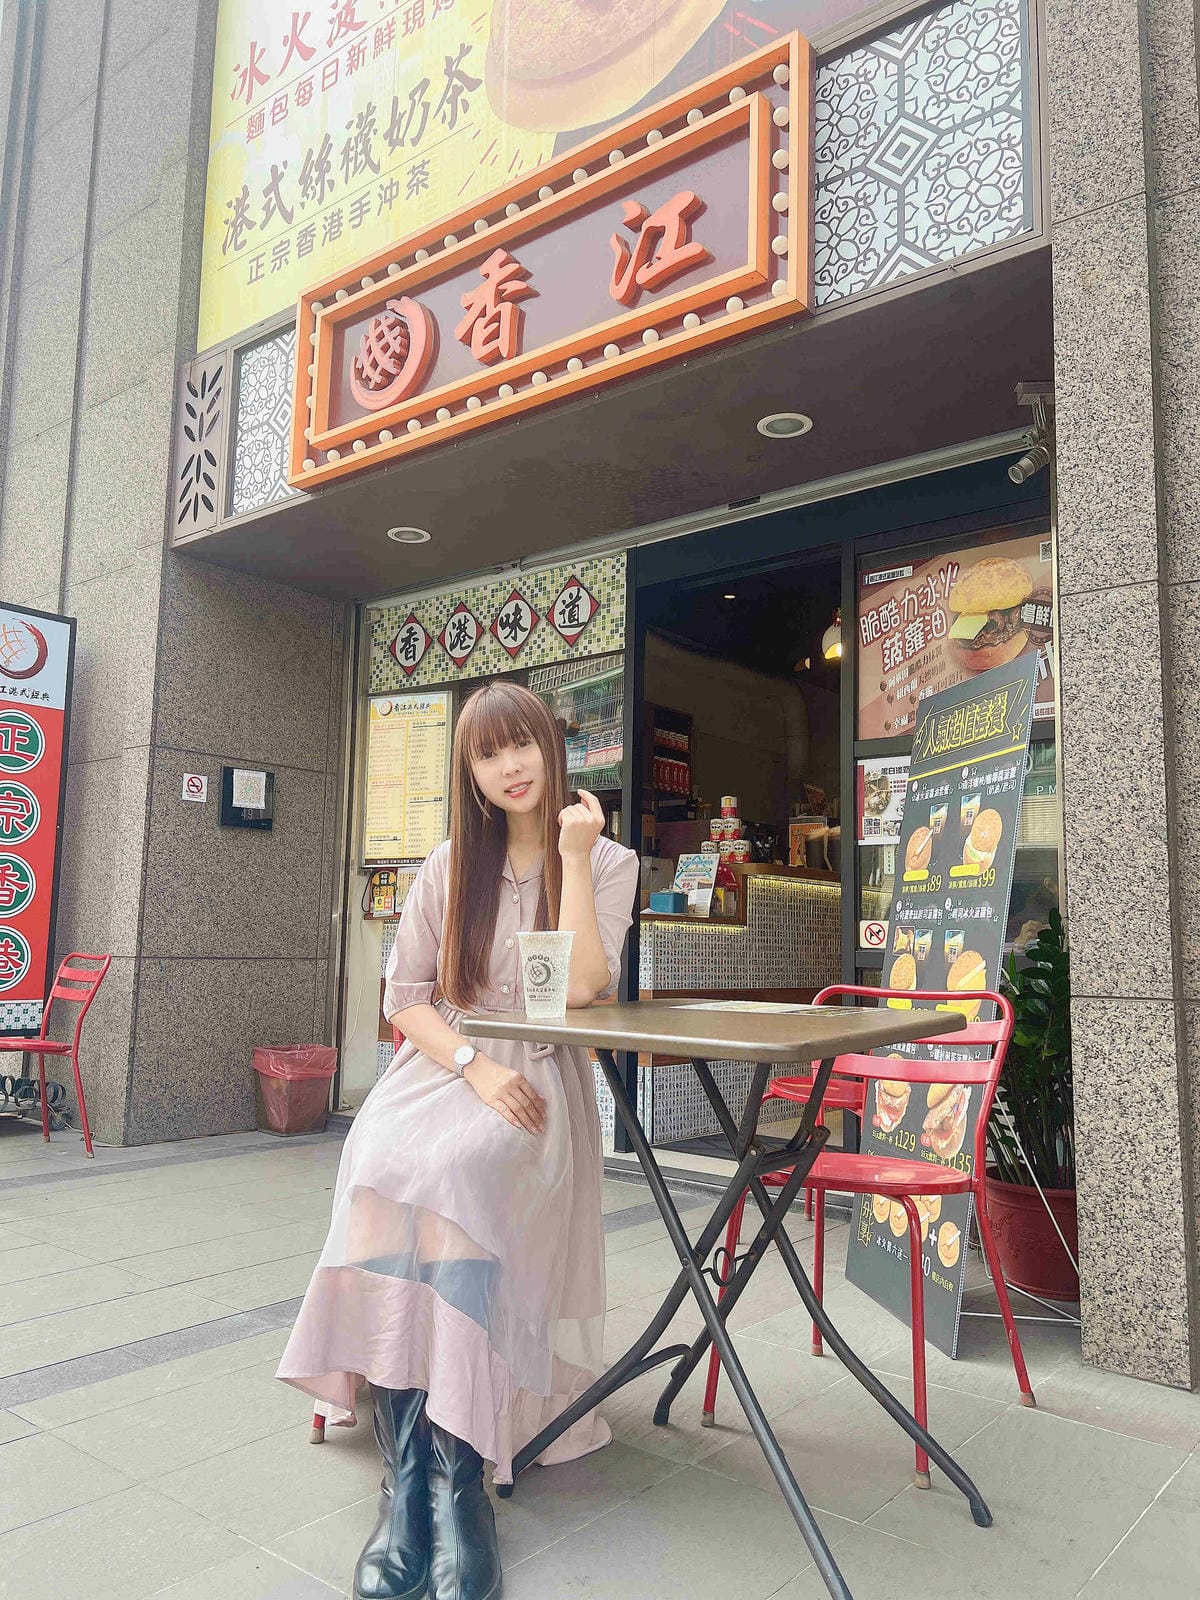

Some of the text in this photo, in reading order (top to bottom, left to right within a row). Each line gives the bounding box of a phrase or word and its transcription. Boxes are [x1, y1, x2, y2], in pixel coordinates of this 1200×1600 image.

[221, 42, 484, 256] 港式絲襪奶茶
[246, 158, 430, 286] 正宗香港手沖茶
[455, 190, 706, 364] 香江
[399, 587, 589, 662] 香港味道
[1021, 602, 1053, 627] 嘗鮮
[895, 1129, 916, 1153] $129
